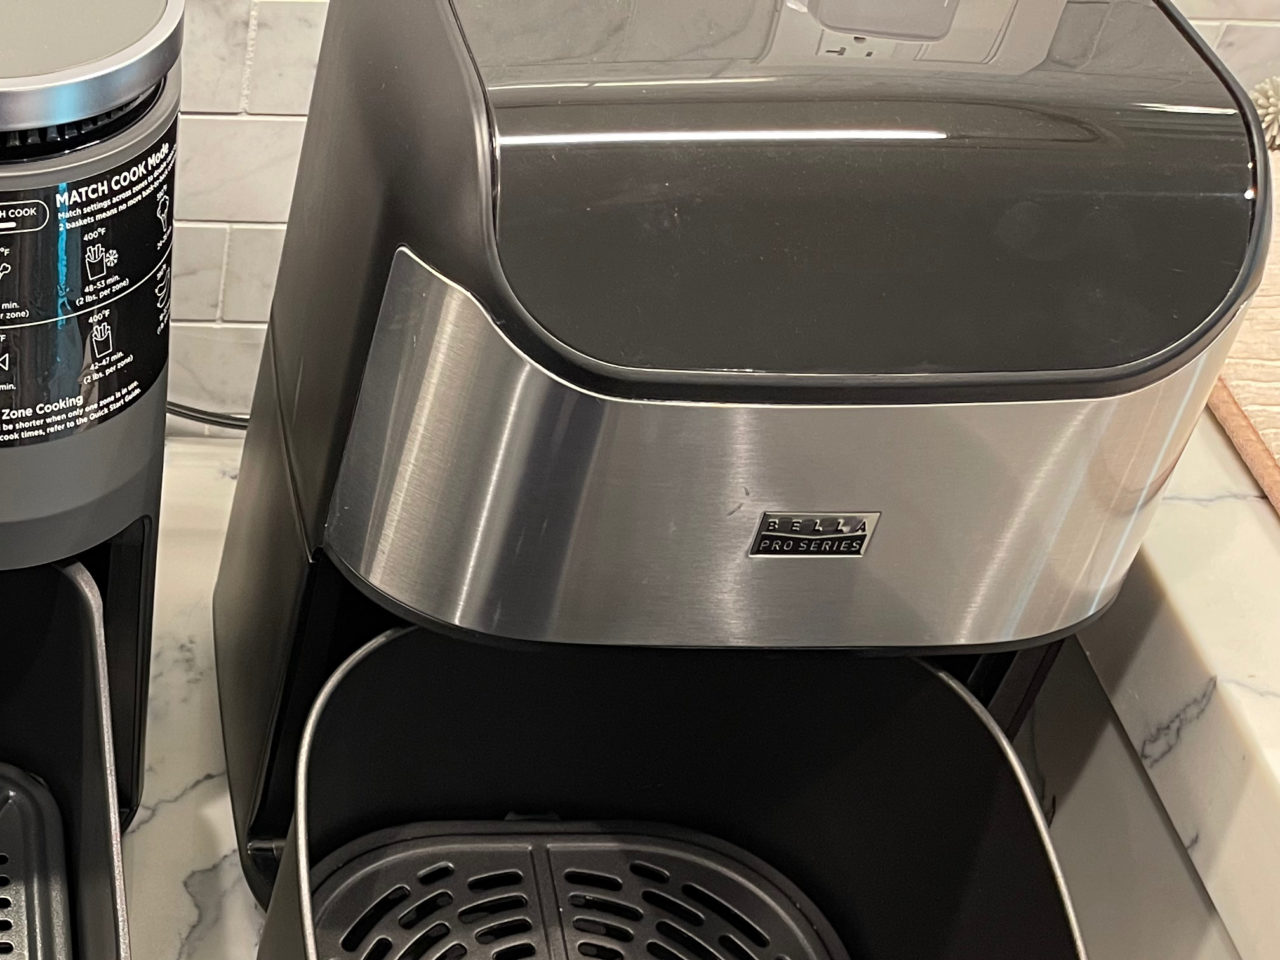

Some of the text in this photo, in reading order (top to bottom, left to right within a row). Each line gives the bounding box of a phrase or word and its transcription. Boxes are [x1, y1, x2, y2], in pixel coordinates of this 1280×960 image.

[55, 180, 109, 207] MATCH
[111, 161, 147, 191] COOK
[147, 142, 169, 171] Mode
[8, 207, 37, 218] COOK
[57, 208, 82, 220] Match
[82, 199, 111, 214] settings
[112, 189, 132, 204] across
[58, 223, 65, 231] 2
[65, 216, 95, 230] baskets
[95, 207, 118, 221] means
[118, 203, 127, 212] no
[1, 301, 20, 310] min.
[6, 309, 30, 319] zone)
[1, 406, 33, 419] Zone
[35, 394, 84, 415] Cooking
[2, 423, 13, 431] be
[15, 419, 44, 430] shorter
[45, 413, 67, 425] when
[67, 408, 84, 420] only
[85, 404, 98, 413] one
[99, 397, 115, 408] zone
[0, 432, 20, 441] cook
[21, 428, 46, 439] times,
[46, 423, 65, 434] refer
[67, 420, 75, 428] to
[75, 415, 88, 425] the
[89, 407, 110, 421] Quick
[768, 518, 867, 533] BELLA
[759, 540, 861, 551] PRO SERIES
